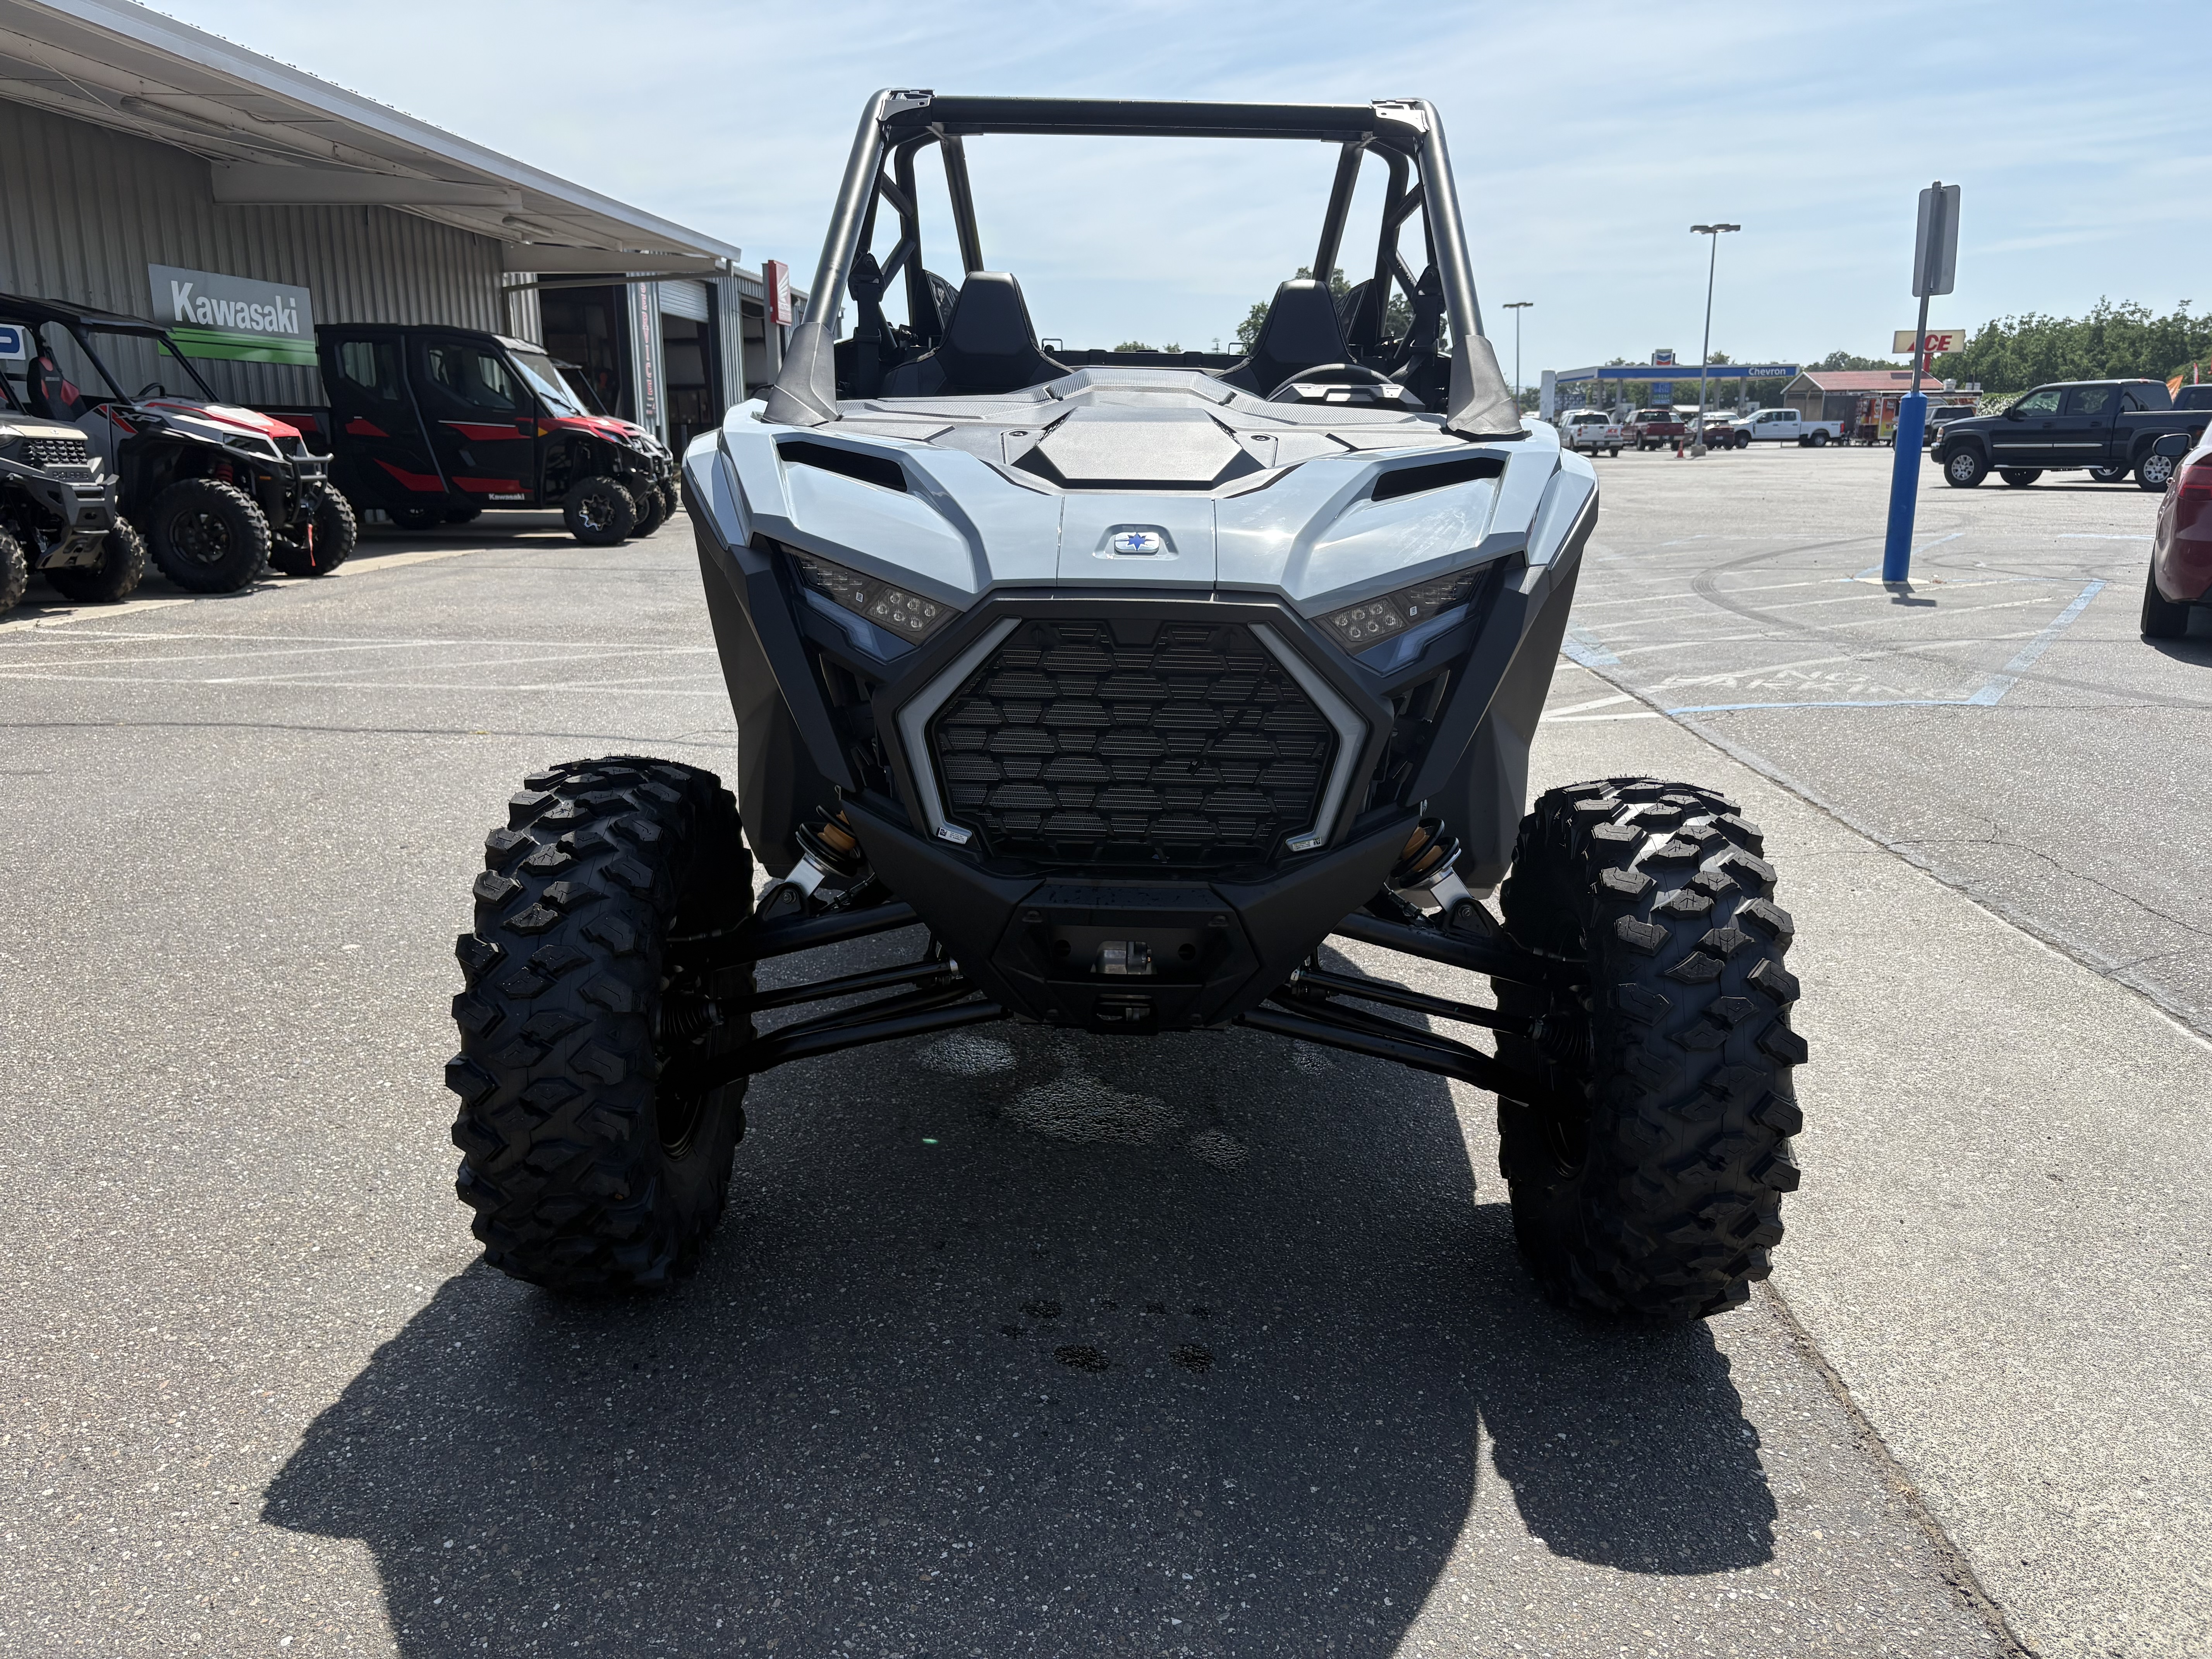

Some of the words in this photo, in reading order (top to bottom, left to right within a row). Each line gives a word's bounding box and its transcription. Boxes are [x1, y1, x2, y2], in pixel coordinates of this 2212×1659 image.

[171, 280, 299, 334] Kawasaki
[1748, 367, 1786, 376] Chevron
[116, 411, 162, 422] XP
[53, 471, 89, 479] POLARIS
